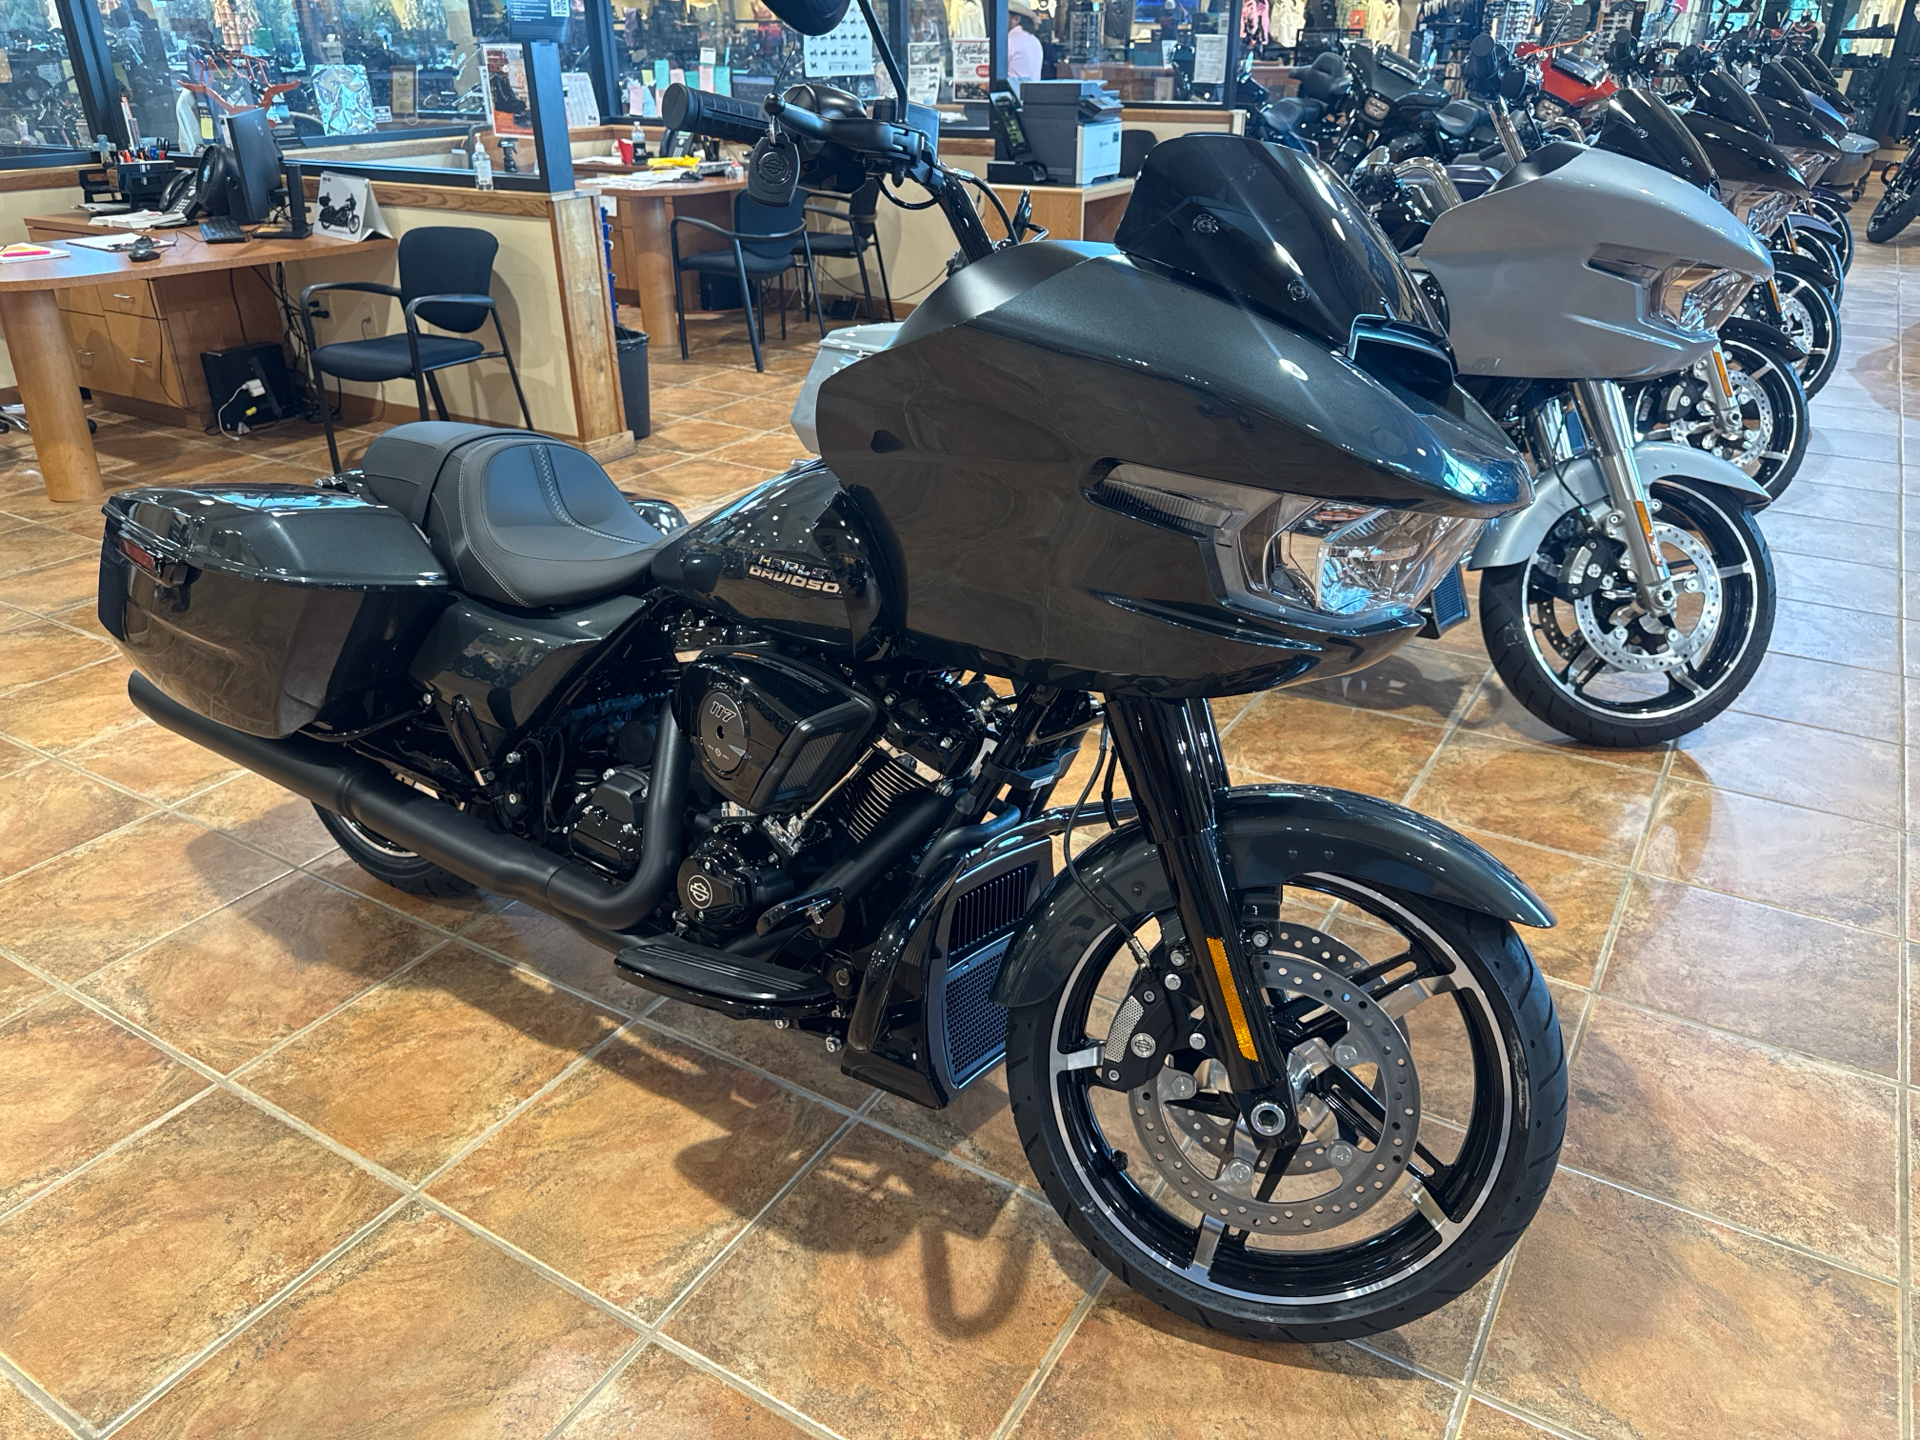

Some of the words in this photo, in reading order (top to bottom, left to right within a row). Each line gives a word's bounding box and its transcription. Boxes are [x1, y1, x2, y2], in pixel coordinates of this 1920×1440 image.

[749, 564, 842, 595] DAVIDSO
[709, 700, 737, 723] 117
[1138, 1260, 1213, 1303] DUNLOP
